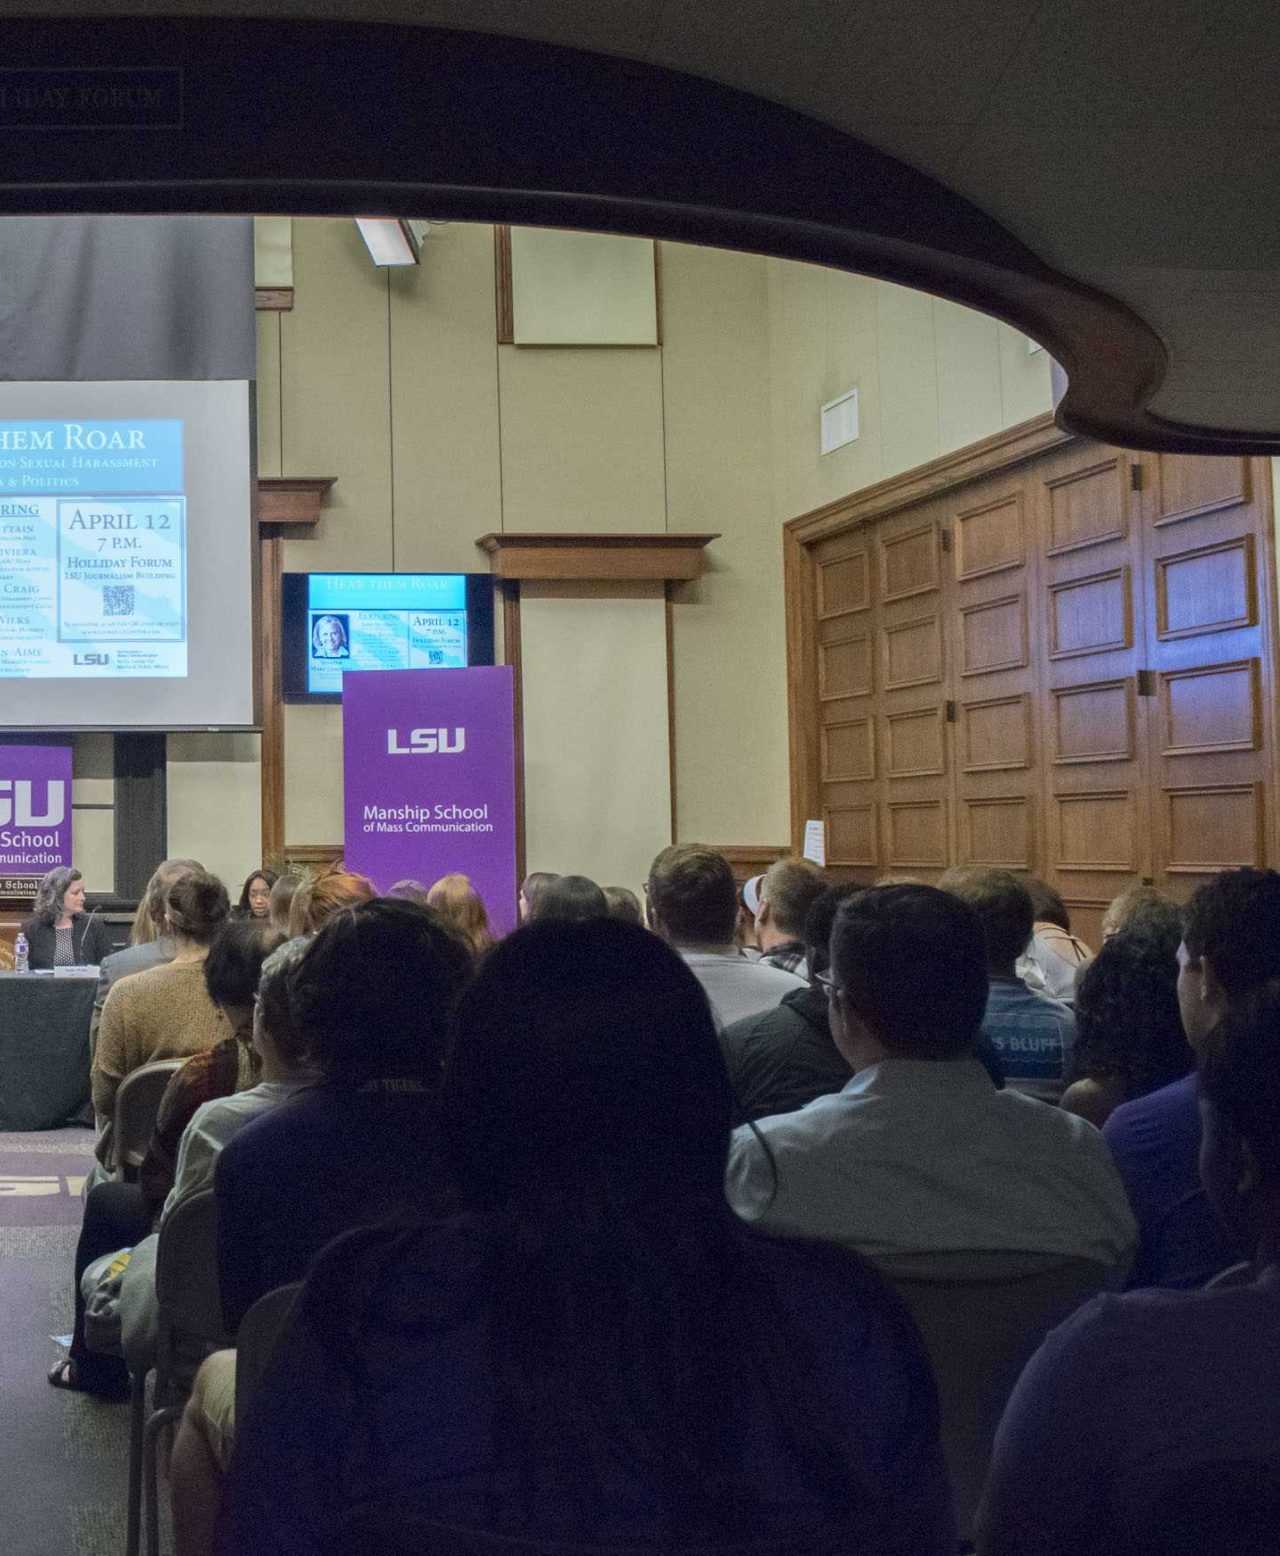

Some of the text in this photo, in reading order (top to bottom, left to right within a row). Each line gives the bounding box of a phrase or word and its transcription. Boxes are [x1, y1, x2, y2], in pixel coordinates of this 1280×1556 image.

[64, 423, 147, 450] ROAR
[18, 456, 66, 469] SEXUAL
[71, 456, 160, 469] HARASSMENT
[8, 478, 18, 488] &
[21, 475, 80, 488] POLITICS
[68, 508, 171, 530] APRIL 12
[97, 536, 142, 553] 7 P.M.
[67, 556, 173, 569] HOLLIDAY FORUM
[4, 583, 40, 594] CRAIG
[72, 653, 111, 667] LSU
[387, 727, 466, 754] LSU
[363, 804, 488, 822] Manship School
[363, 822, 494, 833] of Mass Communication
[0, 831, 60, 849] School
[5, 880, 38, 889] School
